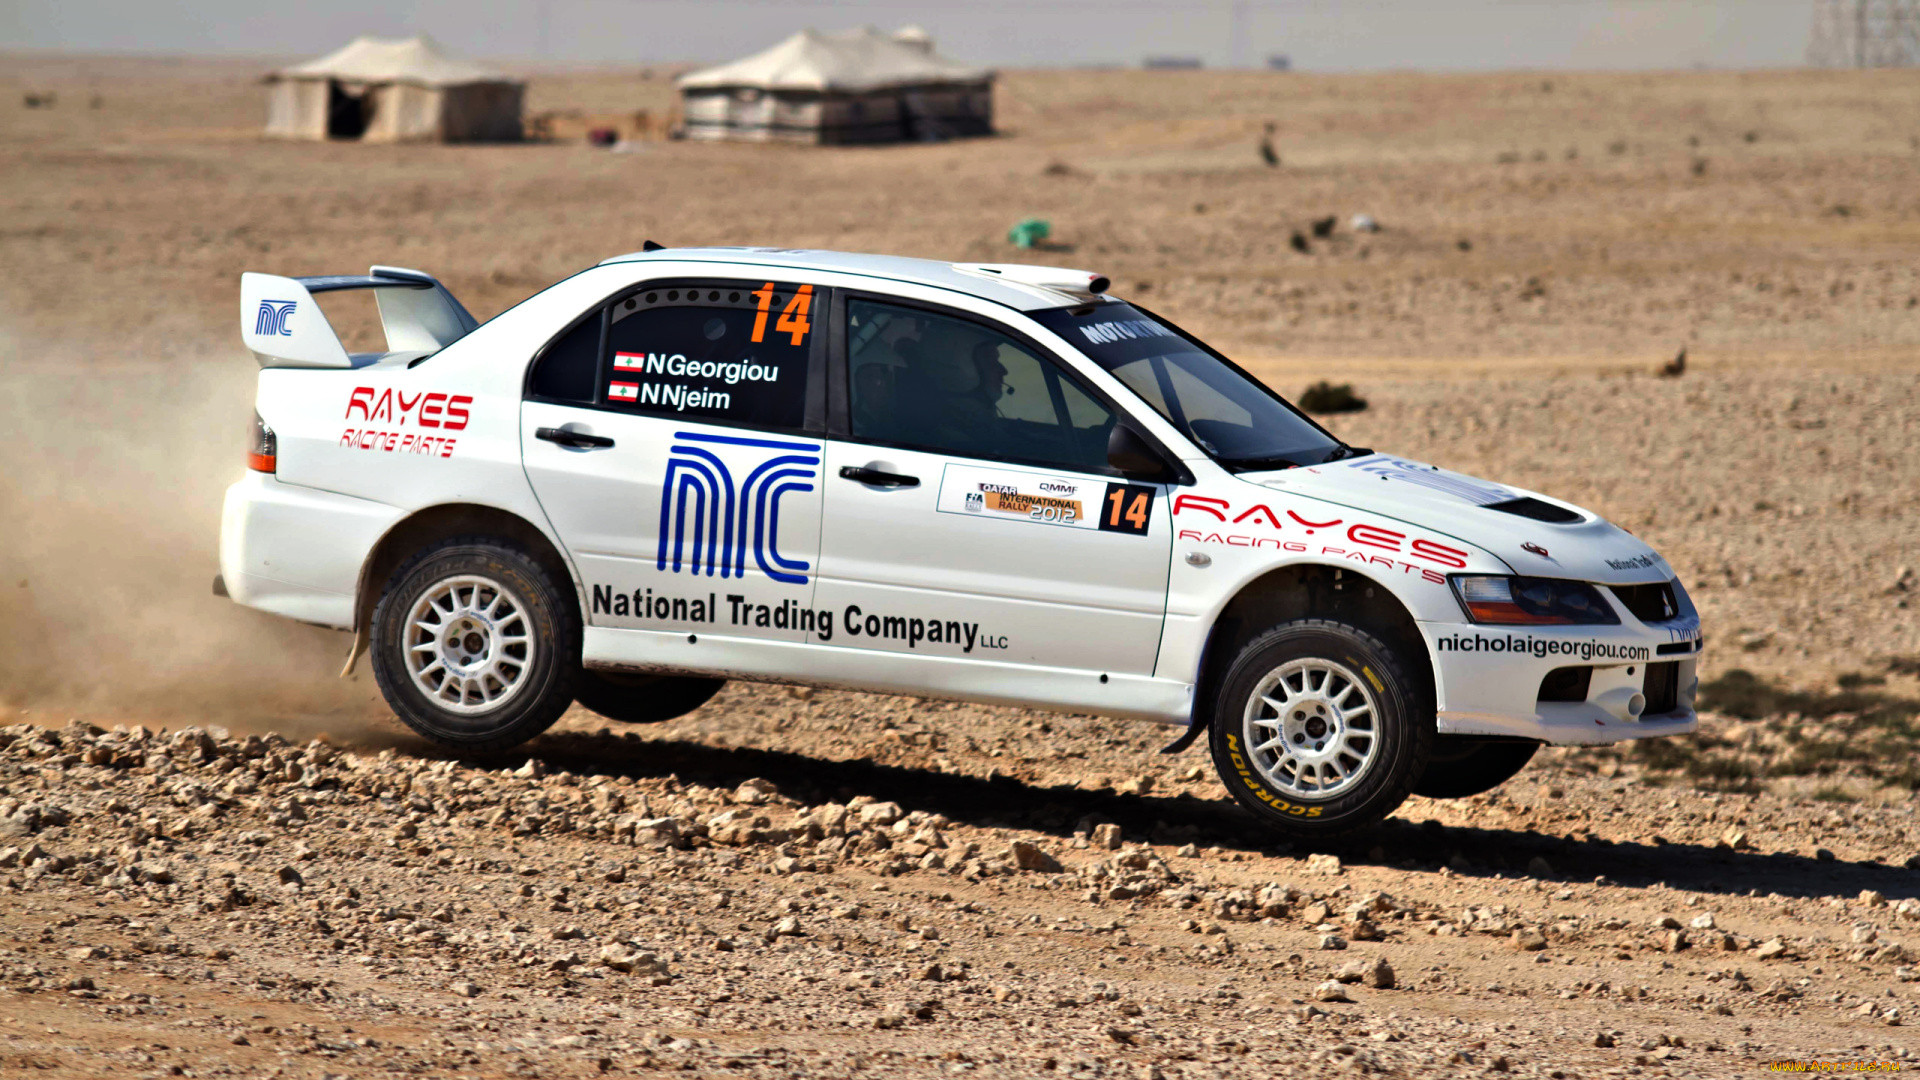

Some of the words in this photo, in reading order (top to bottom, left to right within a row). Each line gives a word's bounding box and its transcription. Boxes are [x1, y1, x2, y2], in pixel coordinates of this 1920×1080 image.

[751, 282, 813, 346] 14
[345, 386, 473, 430] RAYES
[340, 428, 399, 451] RACING
[399, 434, 456, 458] PARTS
[983, 484, 1016, 496] QATAR
[998, 501, 1029, 511] RALLY
[1000, 493, 1076, 510] INTERNATIONAL
[1109, 488, 1148, 529] 14
[1030, 505, 1076, 523] 2012
[1173, 494, 1468, 568] RAYES
[1179, 530, 1308, 552] RACING
[1322, 546, 1446, 585] PARTS
[592, 584, 715, 623] National
[726, 594, 833, 641] Trading
[843, 605, 979, 653] Company
[981, 634, 1008, 650] LLC
[1438, 633, 1649, 661] nicholaigeorgiou.com
[1226, 733, 1324, 817] SCORPION
